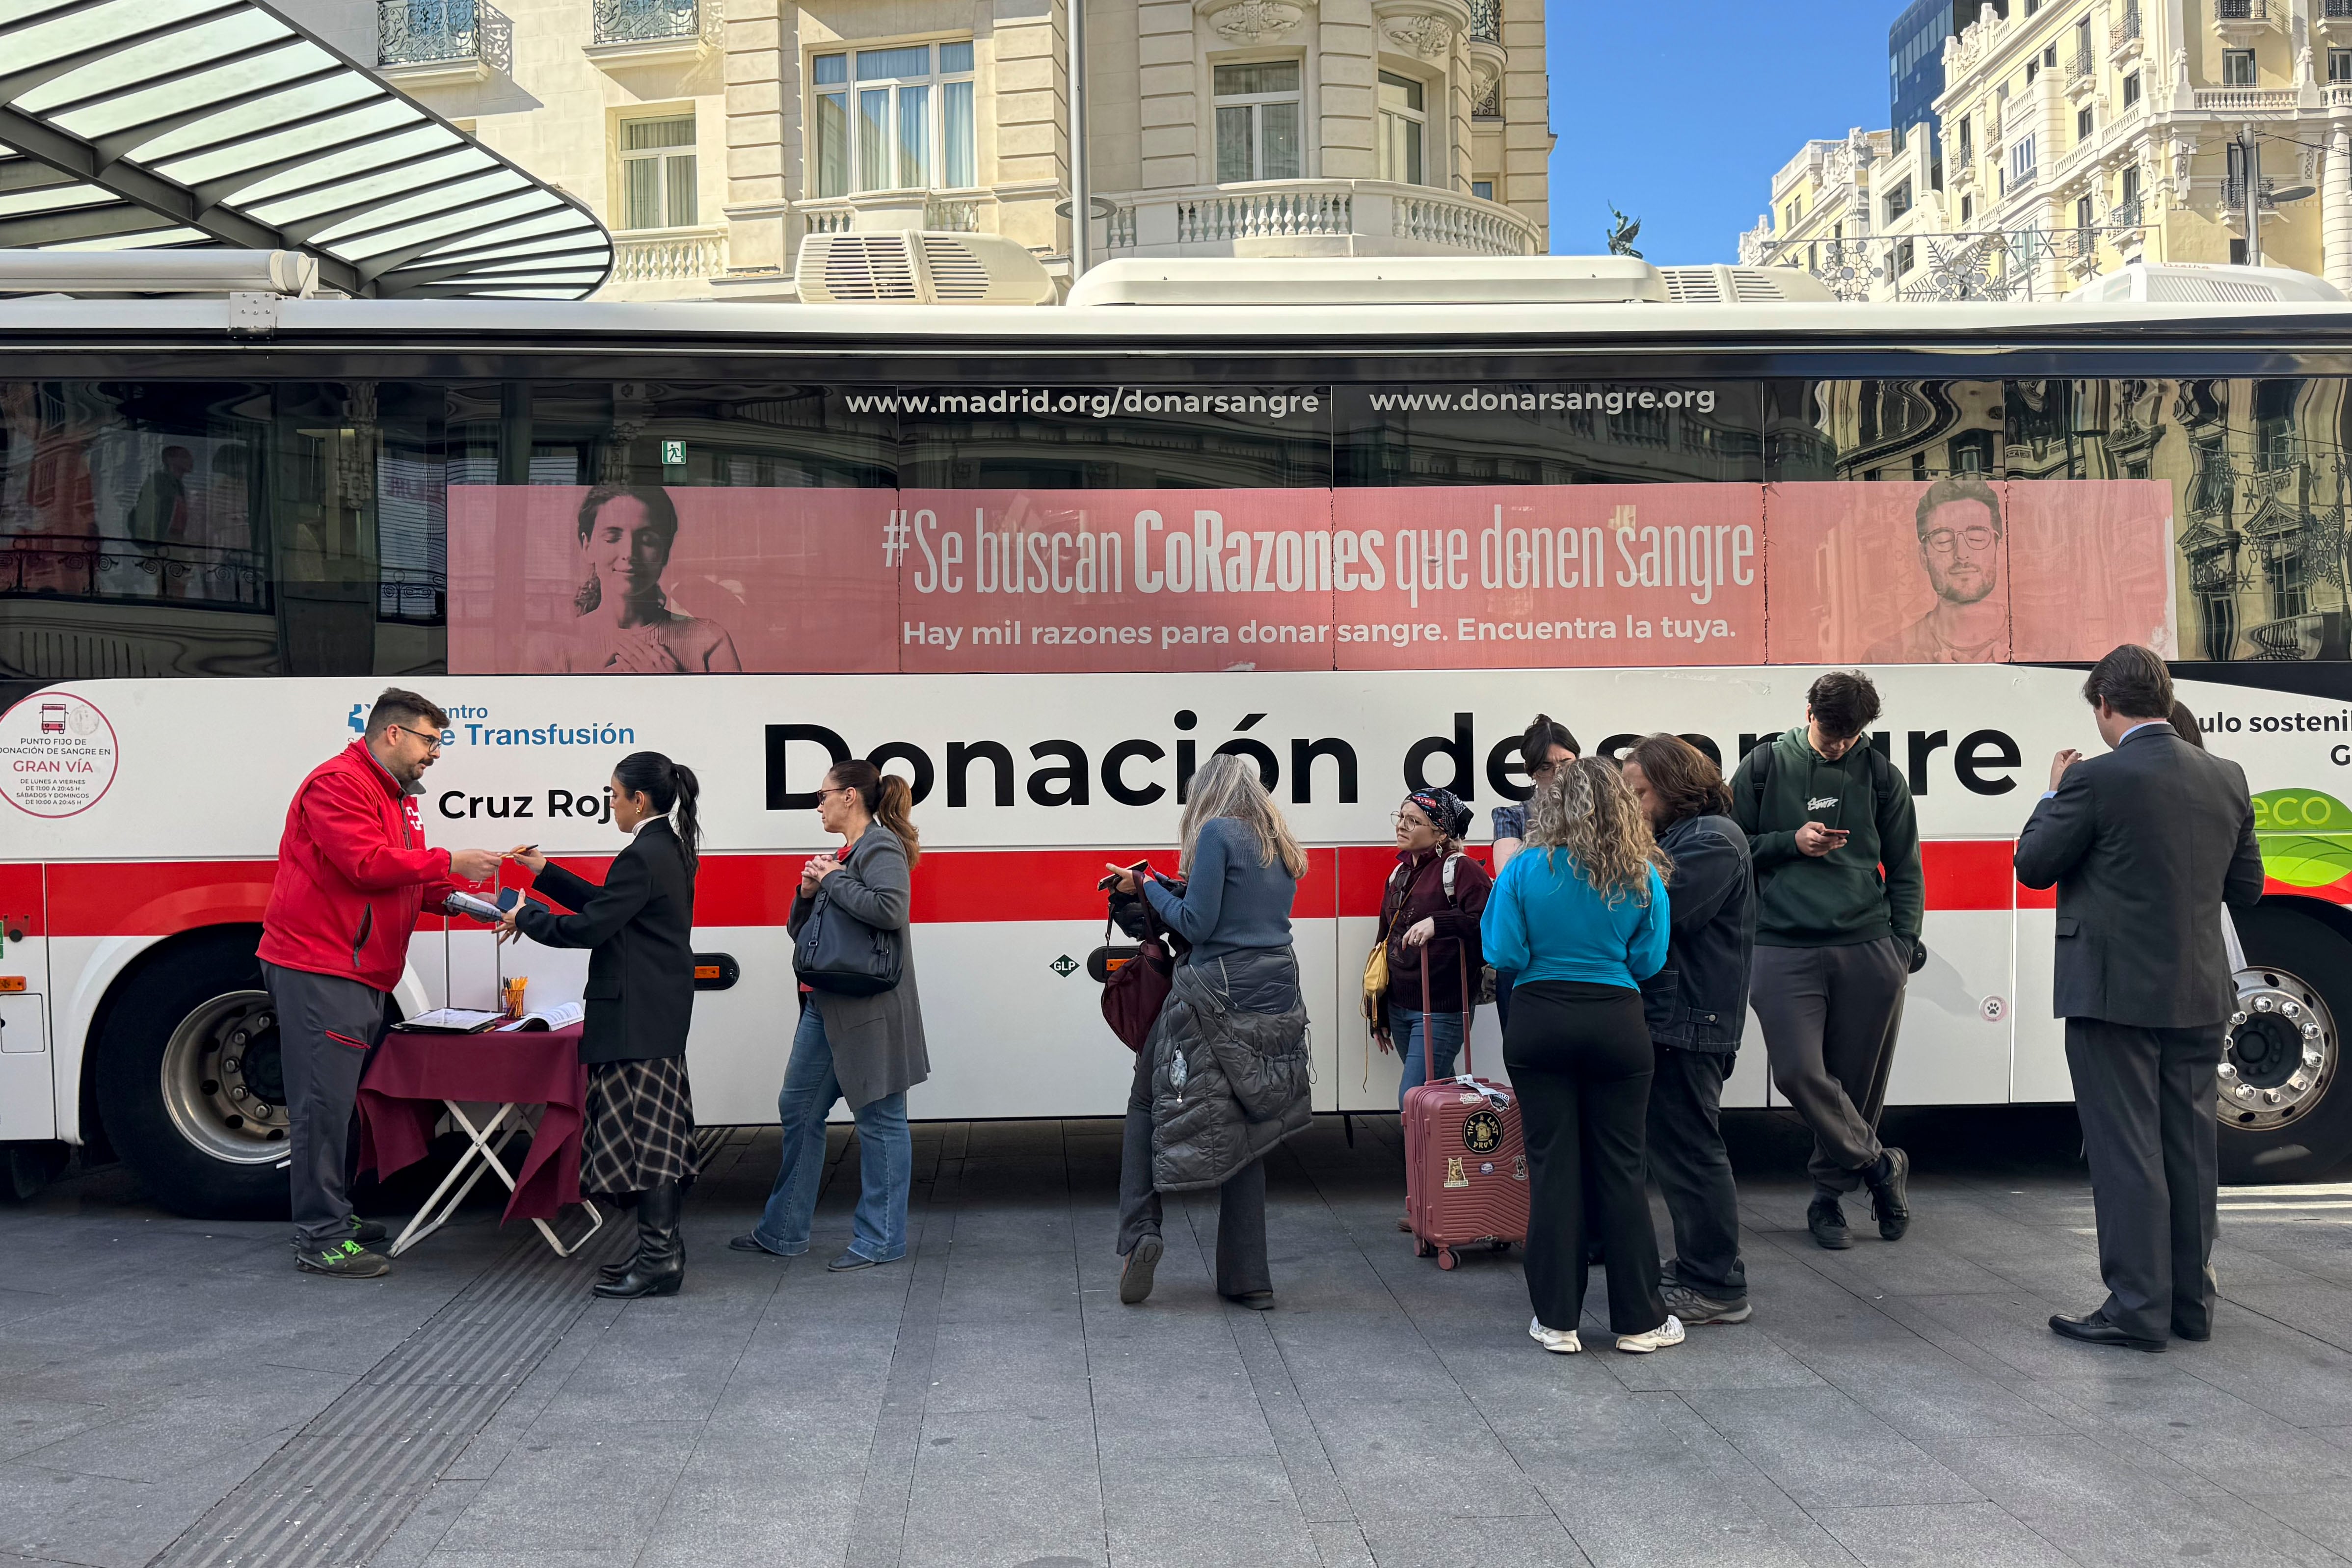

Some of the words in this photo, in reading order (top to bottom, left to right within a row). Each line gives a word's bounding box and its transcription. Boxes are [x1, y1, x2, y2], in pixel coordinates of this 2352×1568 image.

[845, 386, 1319, 418] www.madrid.org/donarsangre
[1369, 387, 1715, 414] www.donarsangre.org
[882, 509, 963, 593] #Se
[976, 507, 1122, 593] buscan
[1134, 509, 1386, 593] CoRazones
[1395, 529, 1468, 608] que
[1480, 504, 1604, 589] donen
[1616, 524, 1754, 605] sangre
[904, 621, 963, 650] Hay
[972, 619, 1021, 645] mil
[1032, 625, 1152, 645] razones
[1162, 625, 1229, 650] para
[1238, 619, 1330, 643] donar
[1337, 621, 1448, 648] sangre.
[1458, 617, 1616, 641] Encuentra
[1626, 614, 1652, 638] la
[1660, 616, 1736, 643] tuya.
[439, 704, 488, 719] entro
[2198, 712, 2242, 733] ulo
[2248, 709, 2352, 733] sosteni
[441, 729, 455, 745] e
[464, 722, 635, 745] Transfusión
[13, 760, 60, 772] GRAN
[65, 758, 93, 773] VÍA
[765, 709, 1358, 810] Donación
[1403, 712, 1537, 802] de
[439, 791, 534, 819] Cruz
[548, 786, 612, 824] Roj
[2251, 796, 2331, 826] eco
[1053, 960, 1076, 971] GLP
[1467, 1120, 1476, 1137] THE
[1487, 1116, 1499, 1136] LAST
[1472, 1139, 1494, 1149] DROP
